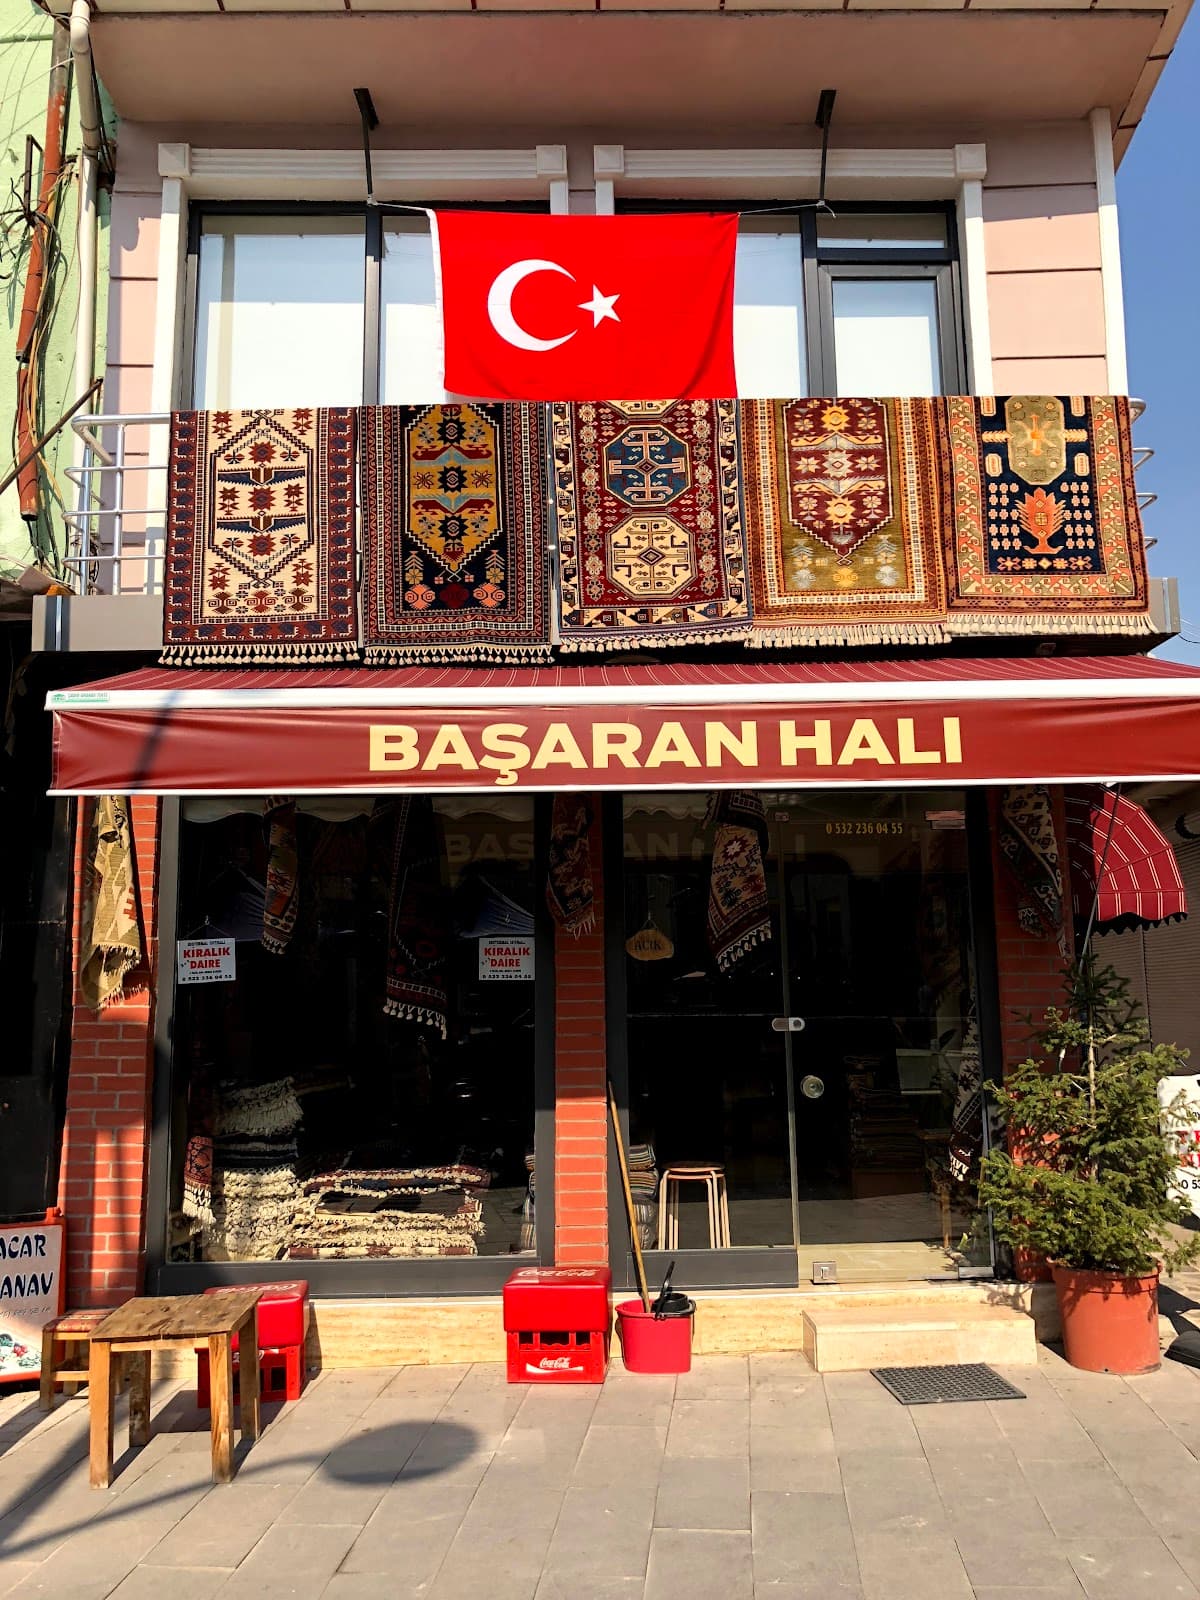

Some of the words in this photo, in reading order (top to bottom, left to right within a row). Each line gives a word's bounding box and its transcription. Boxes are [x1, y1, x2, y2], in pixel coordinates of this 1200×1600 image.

[369, 720, 759, 786] BAŞARAN
[779, 717, 963, 768] HALI
[825, 822, 833, 834] 0
[834, 822, 853, 834] 532
[855, 822, 874, 834] 236
[876, 822, 889, 834] 04
[891, 822, 904, 834] 55
[539, 1356, 572, 1369] Coca-Cola
